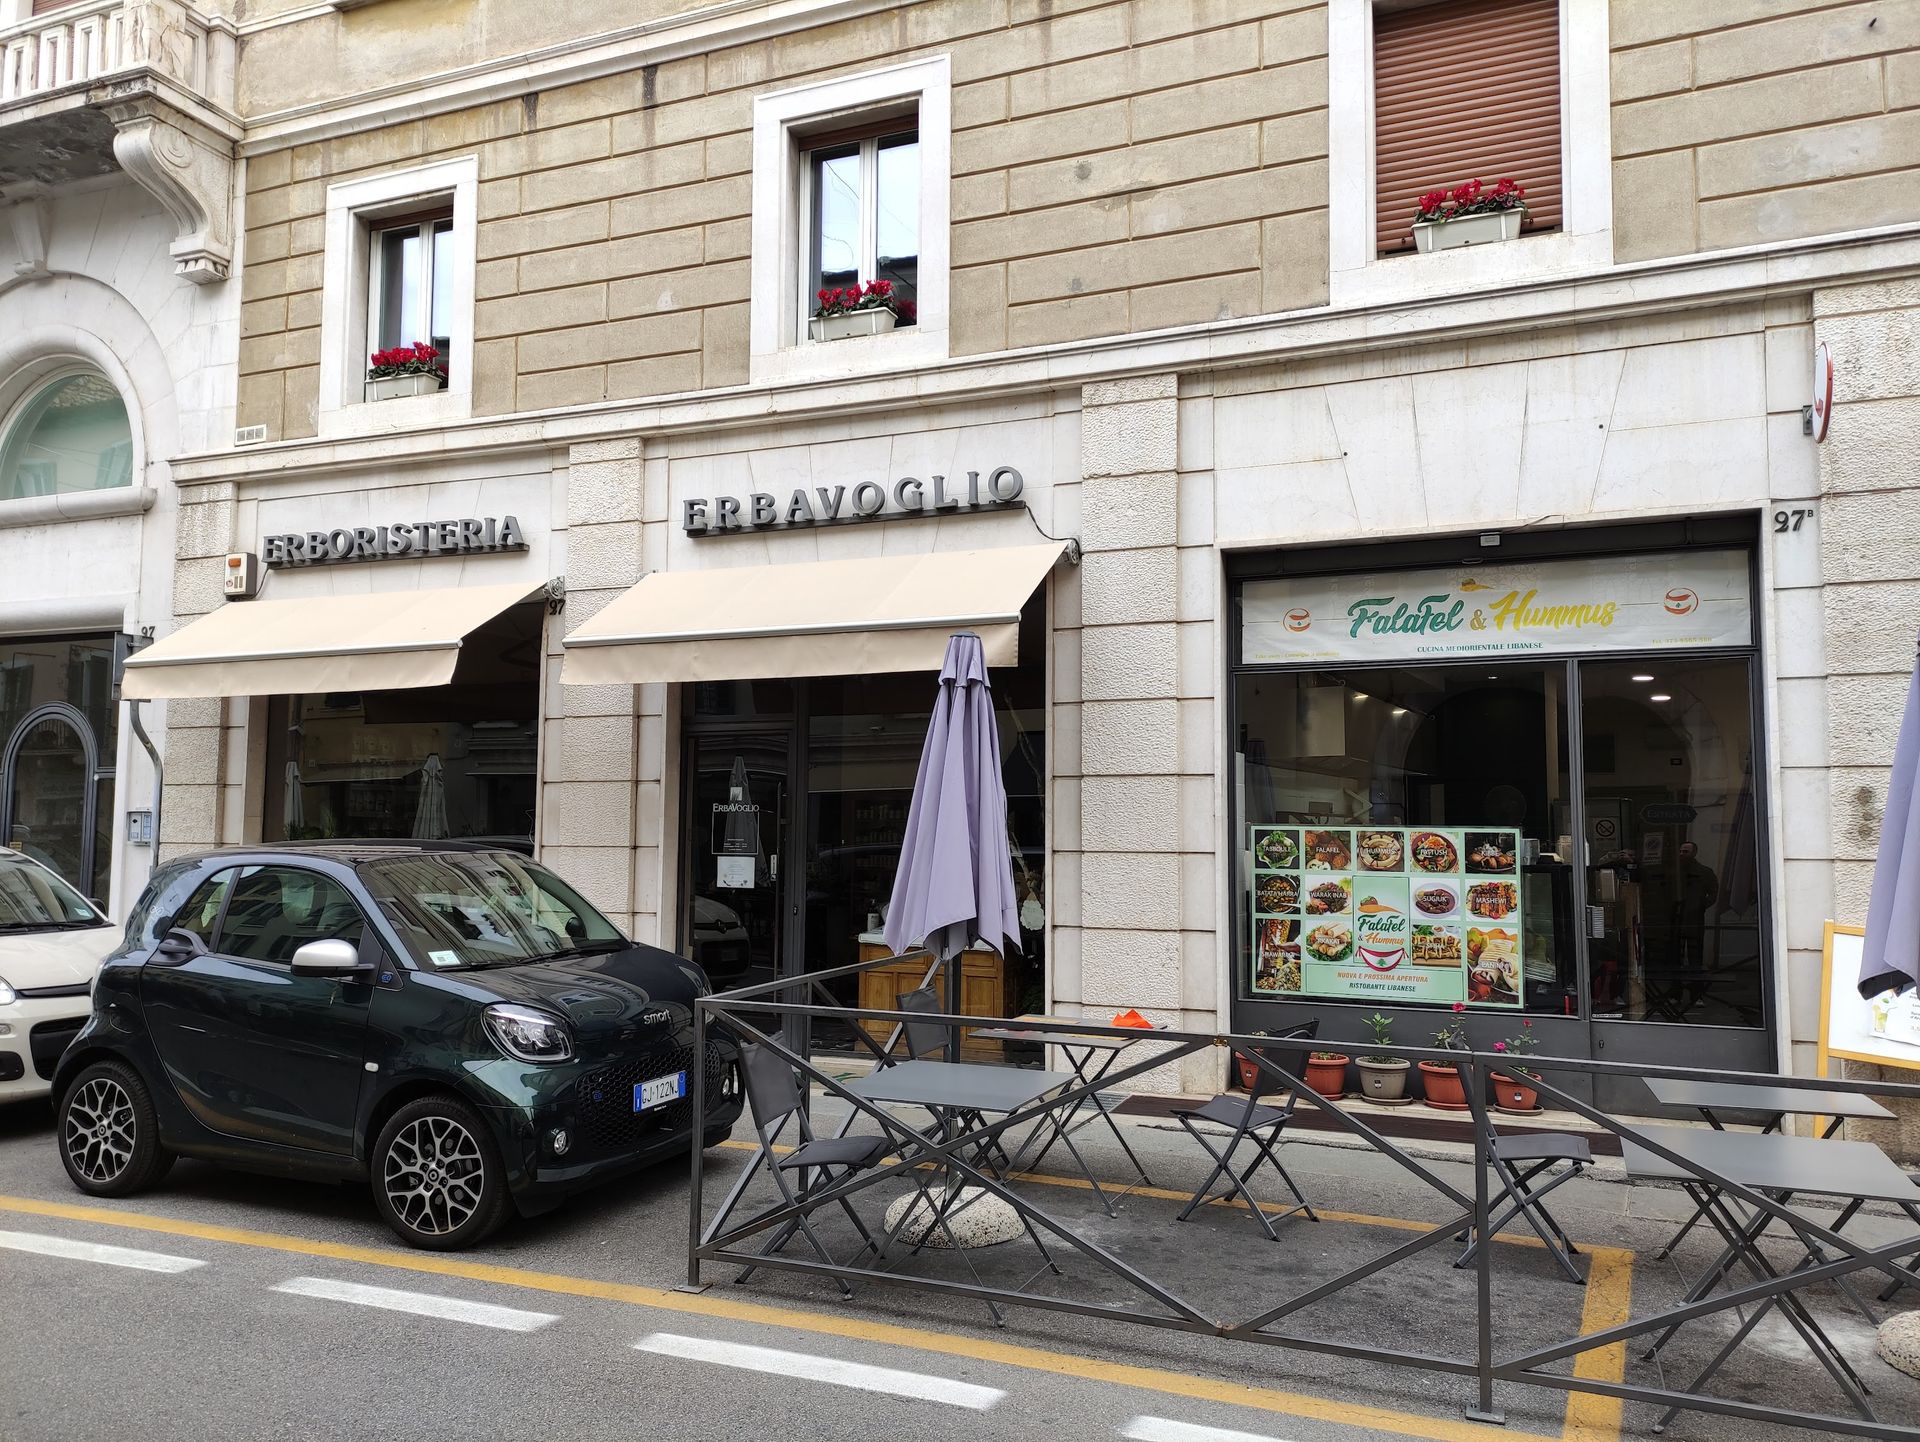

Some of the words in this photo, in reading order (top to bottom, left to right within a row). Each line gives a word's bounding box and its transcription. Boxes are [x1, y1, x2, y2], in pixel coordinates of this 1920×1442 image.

[683, 466, 1024, 534] ERBAVOGLIO
[261, 515, 526, 565] ERBORISTERIA
[549, 599, 566, 616] 97
[1469, 608, 1487, 631] &
[1488, 588, 1621, 631] Hummus
[141, 625, 156, 638] 97
[1416, 645, 1444, 653] CUCINA
[1445, 643, 1505, 653] MEDIORIENTALE
[1506, 641, 1544, 650] LIBANESE
[1315, 846, 1341, 854] FALAFEL
[1363, 973, 1395, 981] PROSSIMA
[1396, 975, 1429, 983] APERTURA
[1348, 982, 1386, 991] RISTORANTE
[1387, 984, 1417, 992] LIBANESE
[643, 1009, 672, 1025] smart
